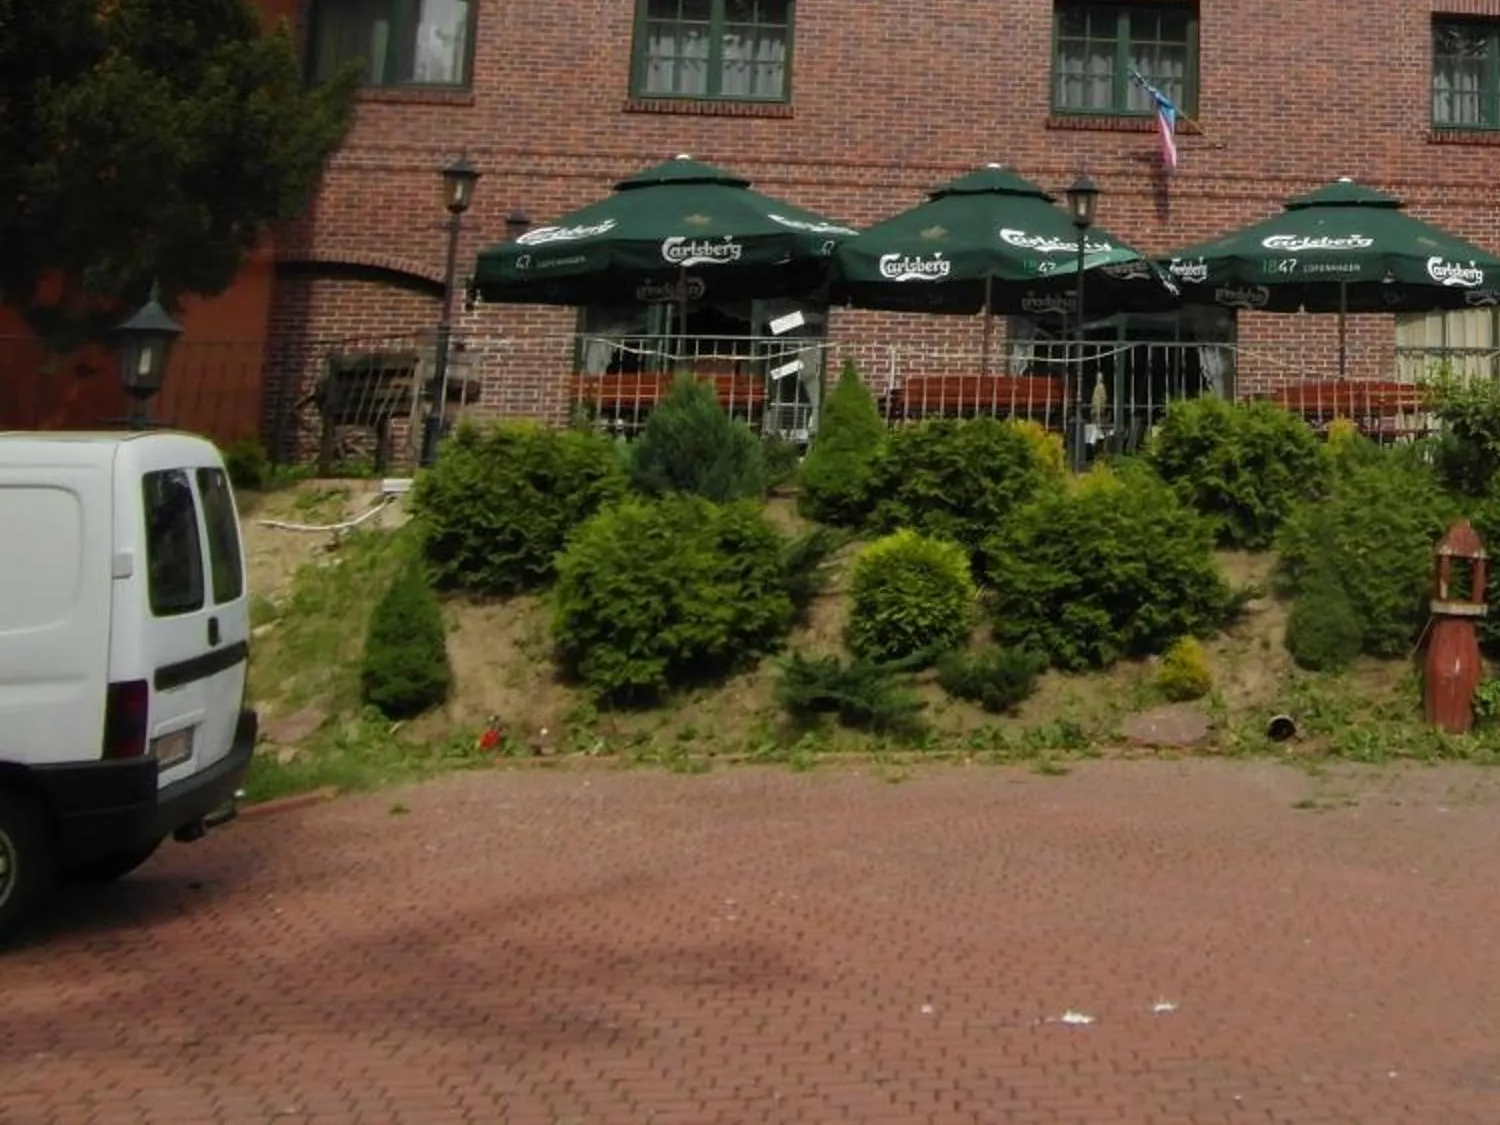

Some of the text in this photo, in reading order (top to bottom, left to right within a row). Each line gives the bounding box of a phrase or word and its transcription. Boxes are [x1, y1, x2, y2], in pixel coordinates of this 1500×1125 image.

[661, 235, 742, 267] Carlsberg
[1261, 234, 1374, 251] Carlsberg
[879, 251, 951, 282] Carlsberg
[1427, 256, 1483, 287] Carlsberg
